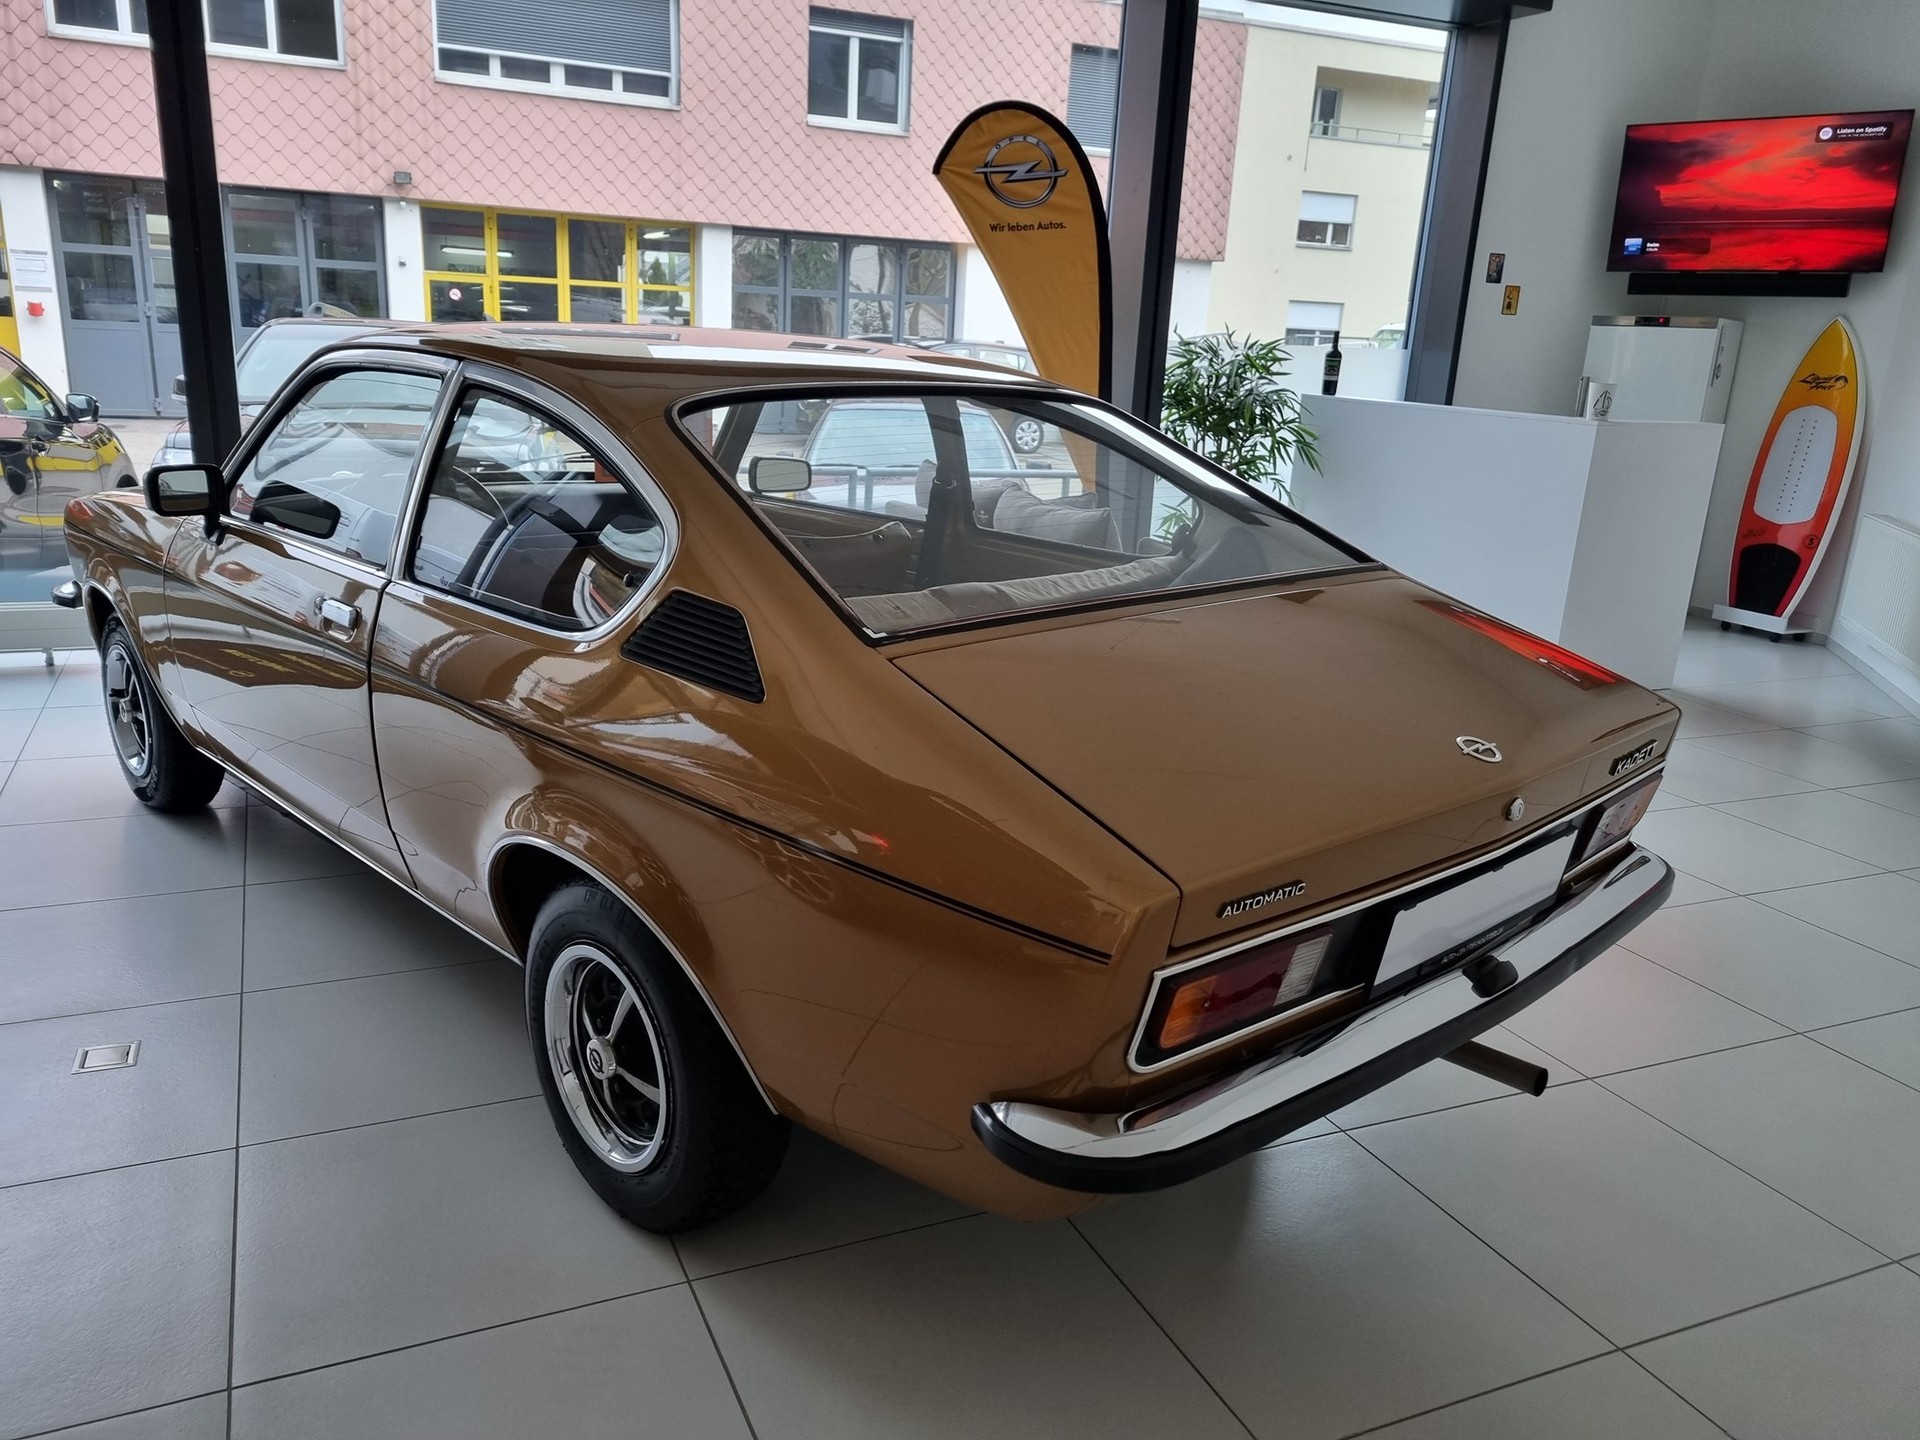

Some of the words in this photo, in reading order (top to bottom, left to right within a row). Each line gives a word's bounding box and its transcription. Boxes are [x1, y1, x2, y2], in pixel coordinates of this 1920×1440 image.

[995, 135, 1042, 150] OPEL
[989, 223, 1006, 233] Wir
[1007, 222, 1035, 232] leben
[1036, 221, 1067, 231] Autos.
[1614, 741, 1659, 776] KADETT
[1221, 882, 1306, 919] AUTOMATIC
